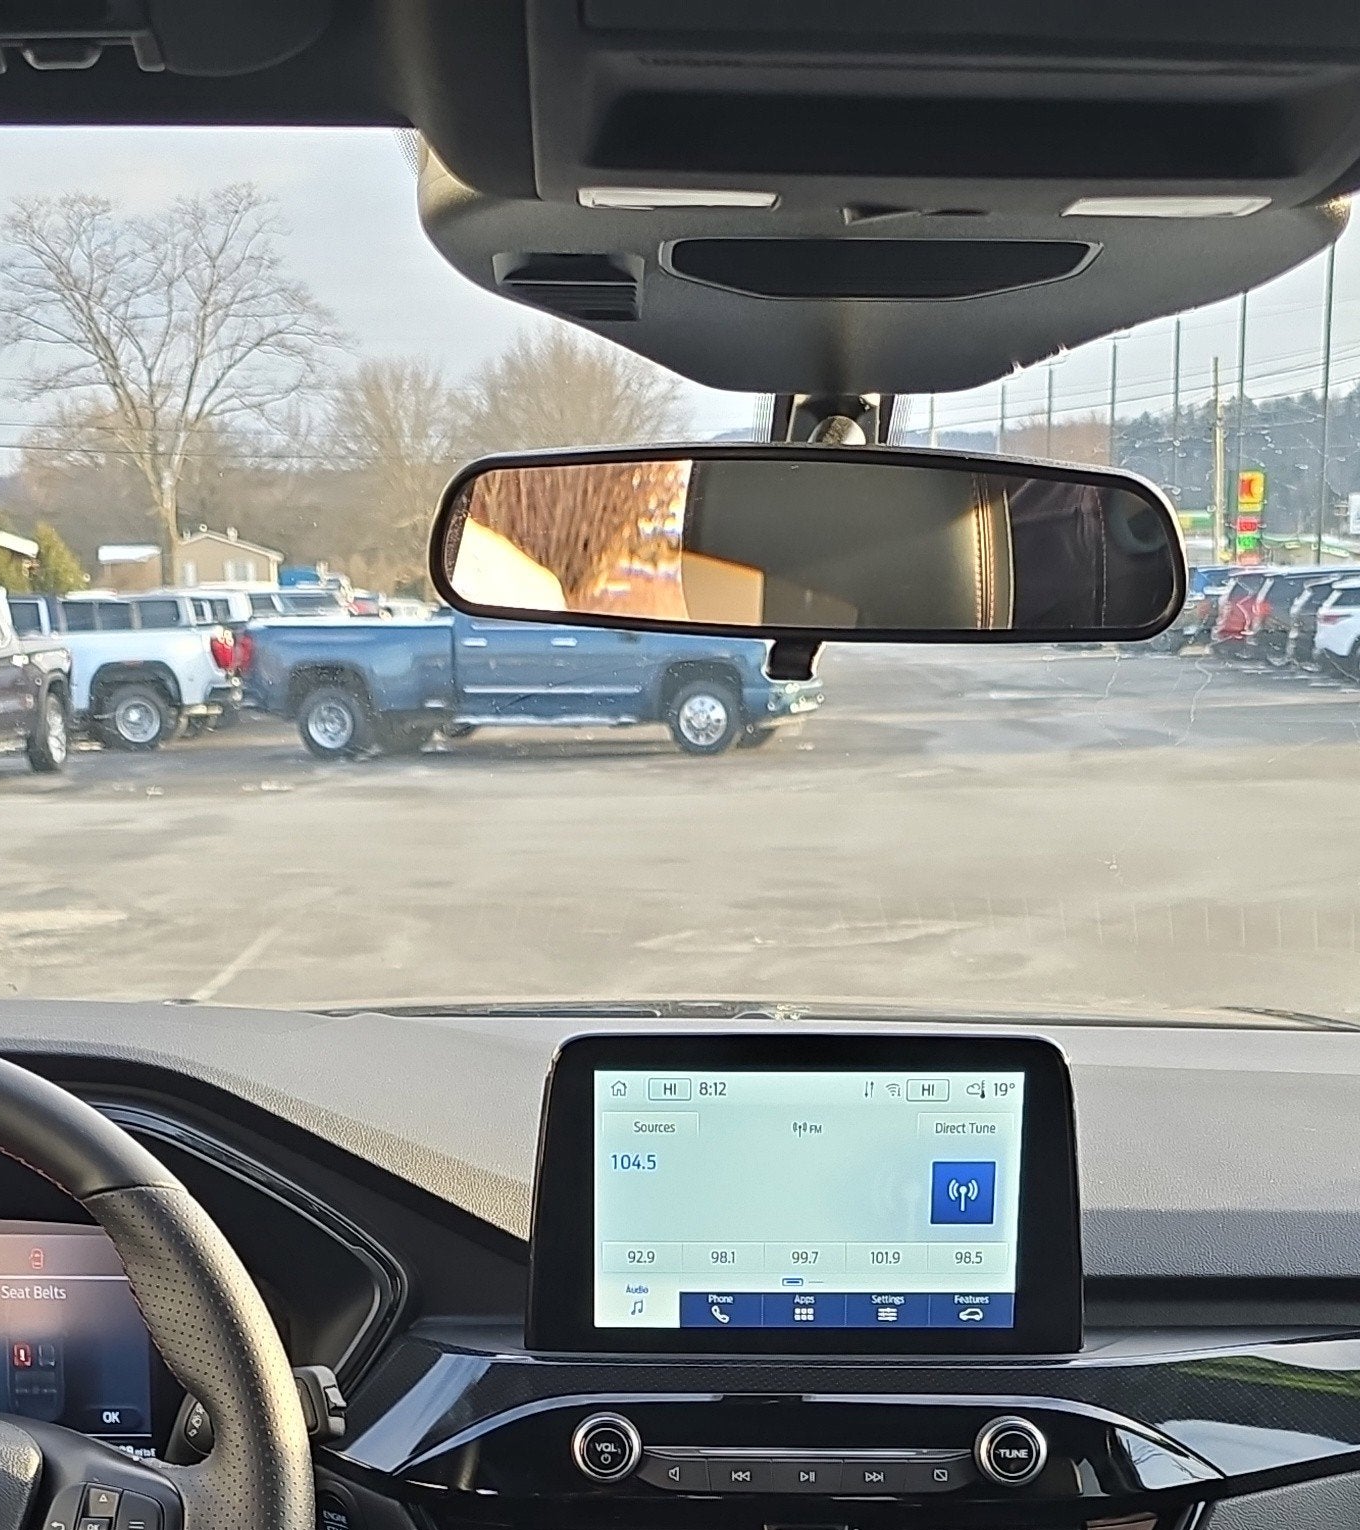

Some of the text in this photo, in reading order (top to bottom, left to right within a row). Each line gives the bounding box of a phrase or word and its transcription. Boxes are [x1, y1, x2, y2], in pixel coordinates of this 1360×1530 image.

[662, 1081, 727, 1097] HI 8:12
[920, 1082, 1016, 1097] HI 19°
[633, 1121, 676, 1133] Sources
[809, 1124, 823, 1134] FM
[934, 1122, 997, 1134] Direct Tune
[611, 1154, 657, 1170] 104.5
[627, 1250, 983, 1264] 92.9 98.1 99.7 101.9 98.5
[0, 1284, 67, 1300] Seat Belts
[625, 1284, 649, 1294] Audio
[707, 1294, 735, 1304] Phone
[794, 1294, 816, 1305] Apps
[870, 1294, 905, 1305] Settings
[953, 1294, 990, 1304] Features
[102, 1409, 121, 1424] OK
[594, 1441, 618, 1453] VOL
[998, 1448, 1029, 1459] TUNE
